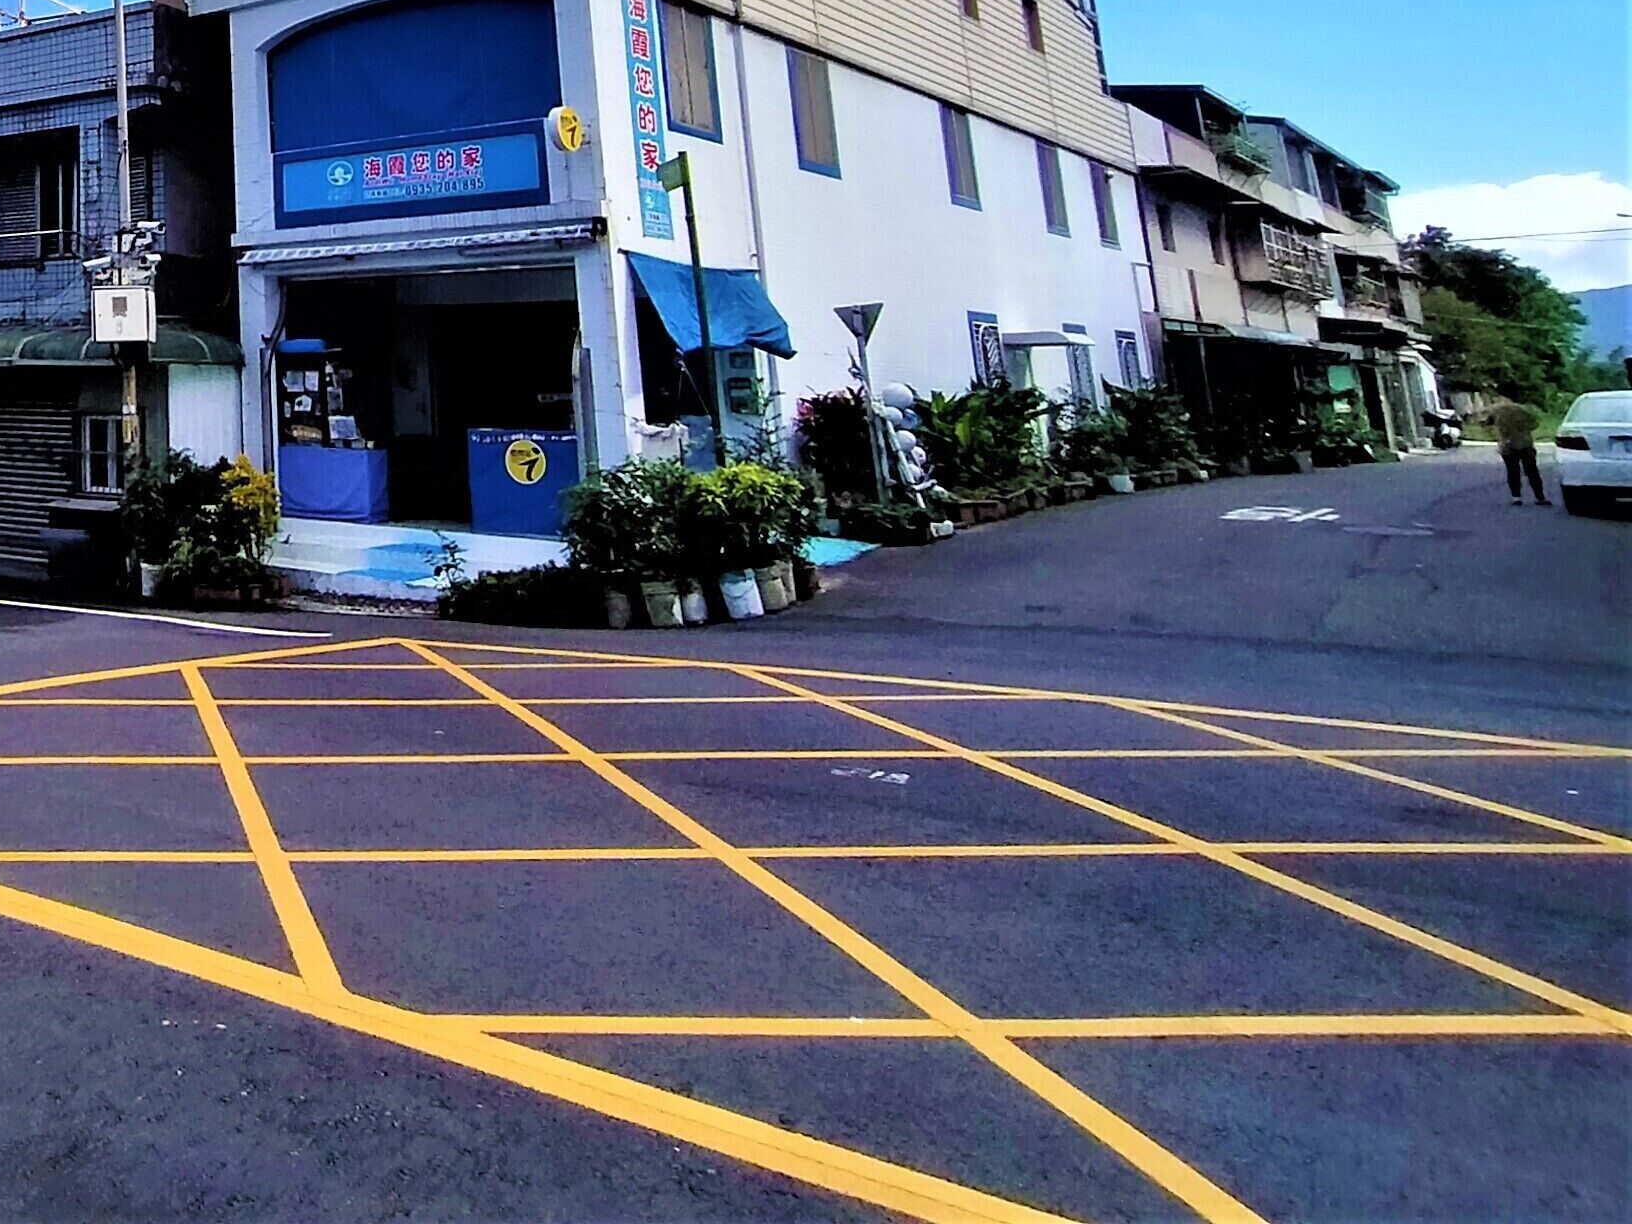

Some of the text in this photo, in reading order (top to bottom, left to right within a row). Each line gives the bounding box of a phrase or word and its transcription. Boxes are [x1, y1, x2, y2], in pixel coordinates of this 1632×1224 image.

[364, 146, 482, 178] 海霞您的家
